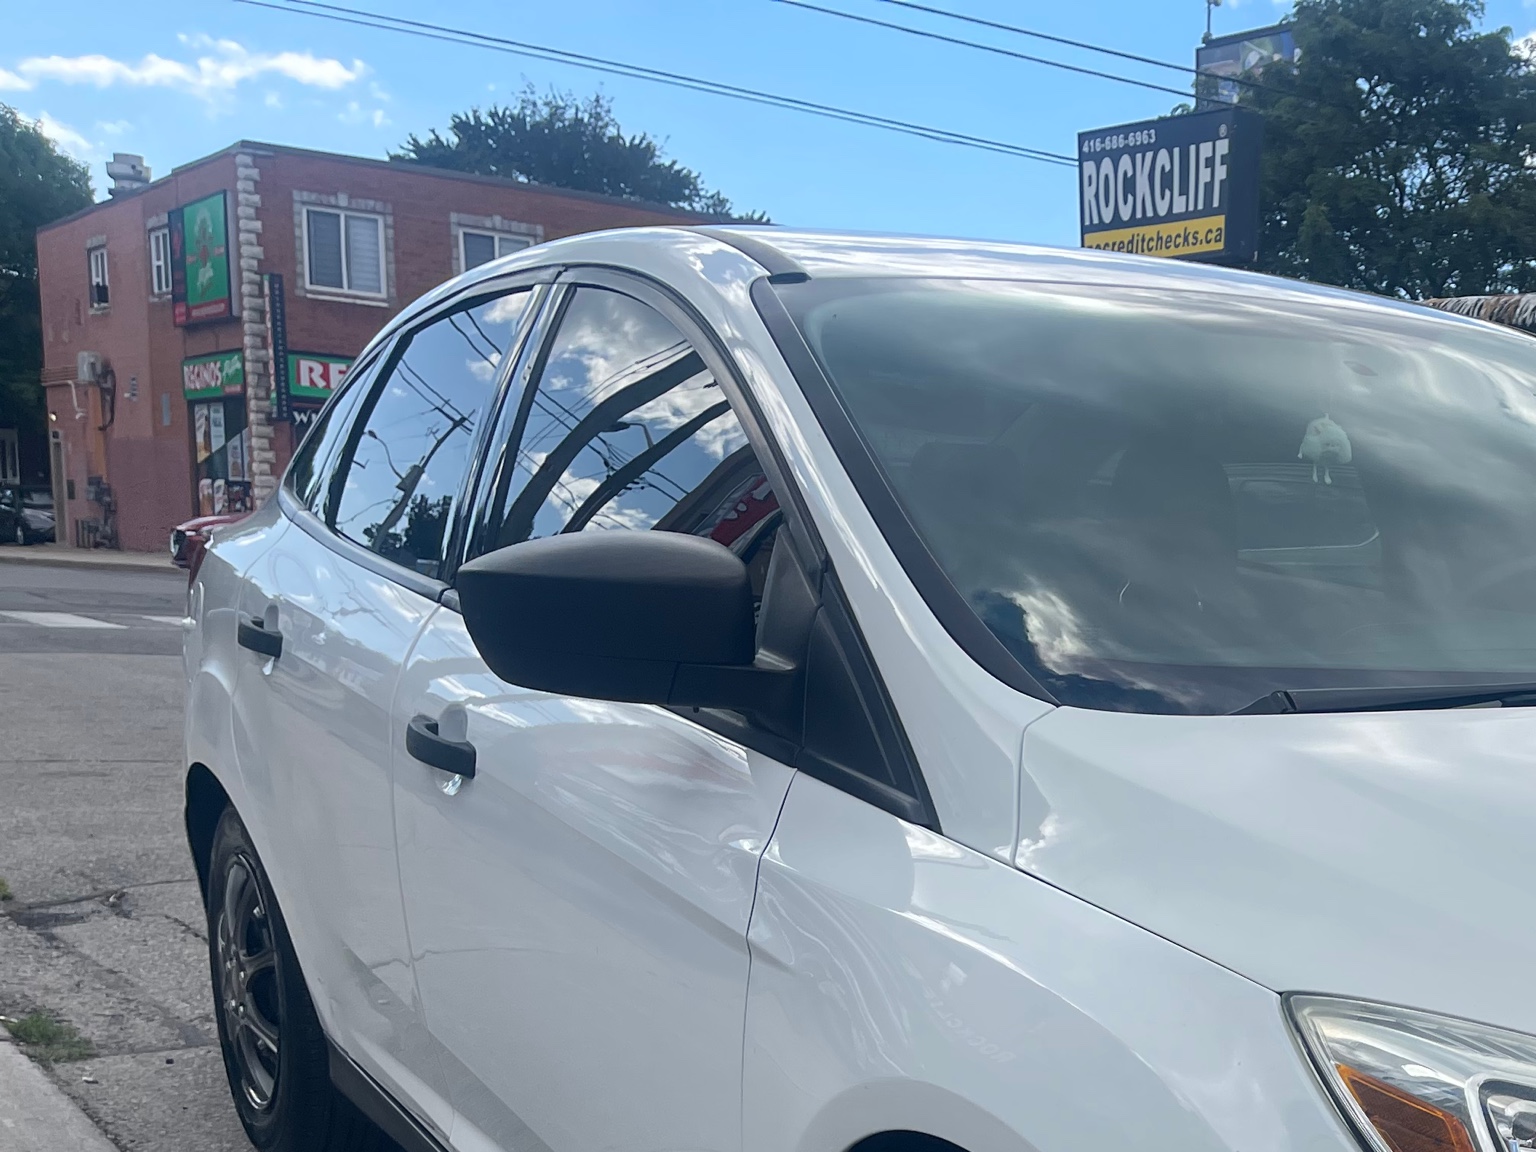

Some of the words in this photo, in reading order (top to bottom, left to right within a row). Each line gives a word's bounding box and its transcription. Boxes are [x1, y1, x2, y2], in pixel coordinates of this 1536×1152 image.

[1082, 128, 1157, 153] 416-686-6963
[1082, 138, 1230, 226] ROCKCLIFF
[1086, 226, 1223, 254] creditchecks.ca
